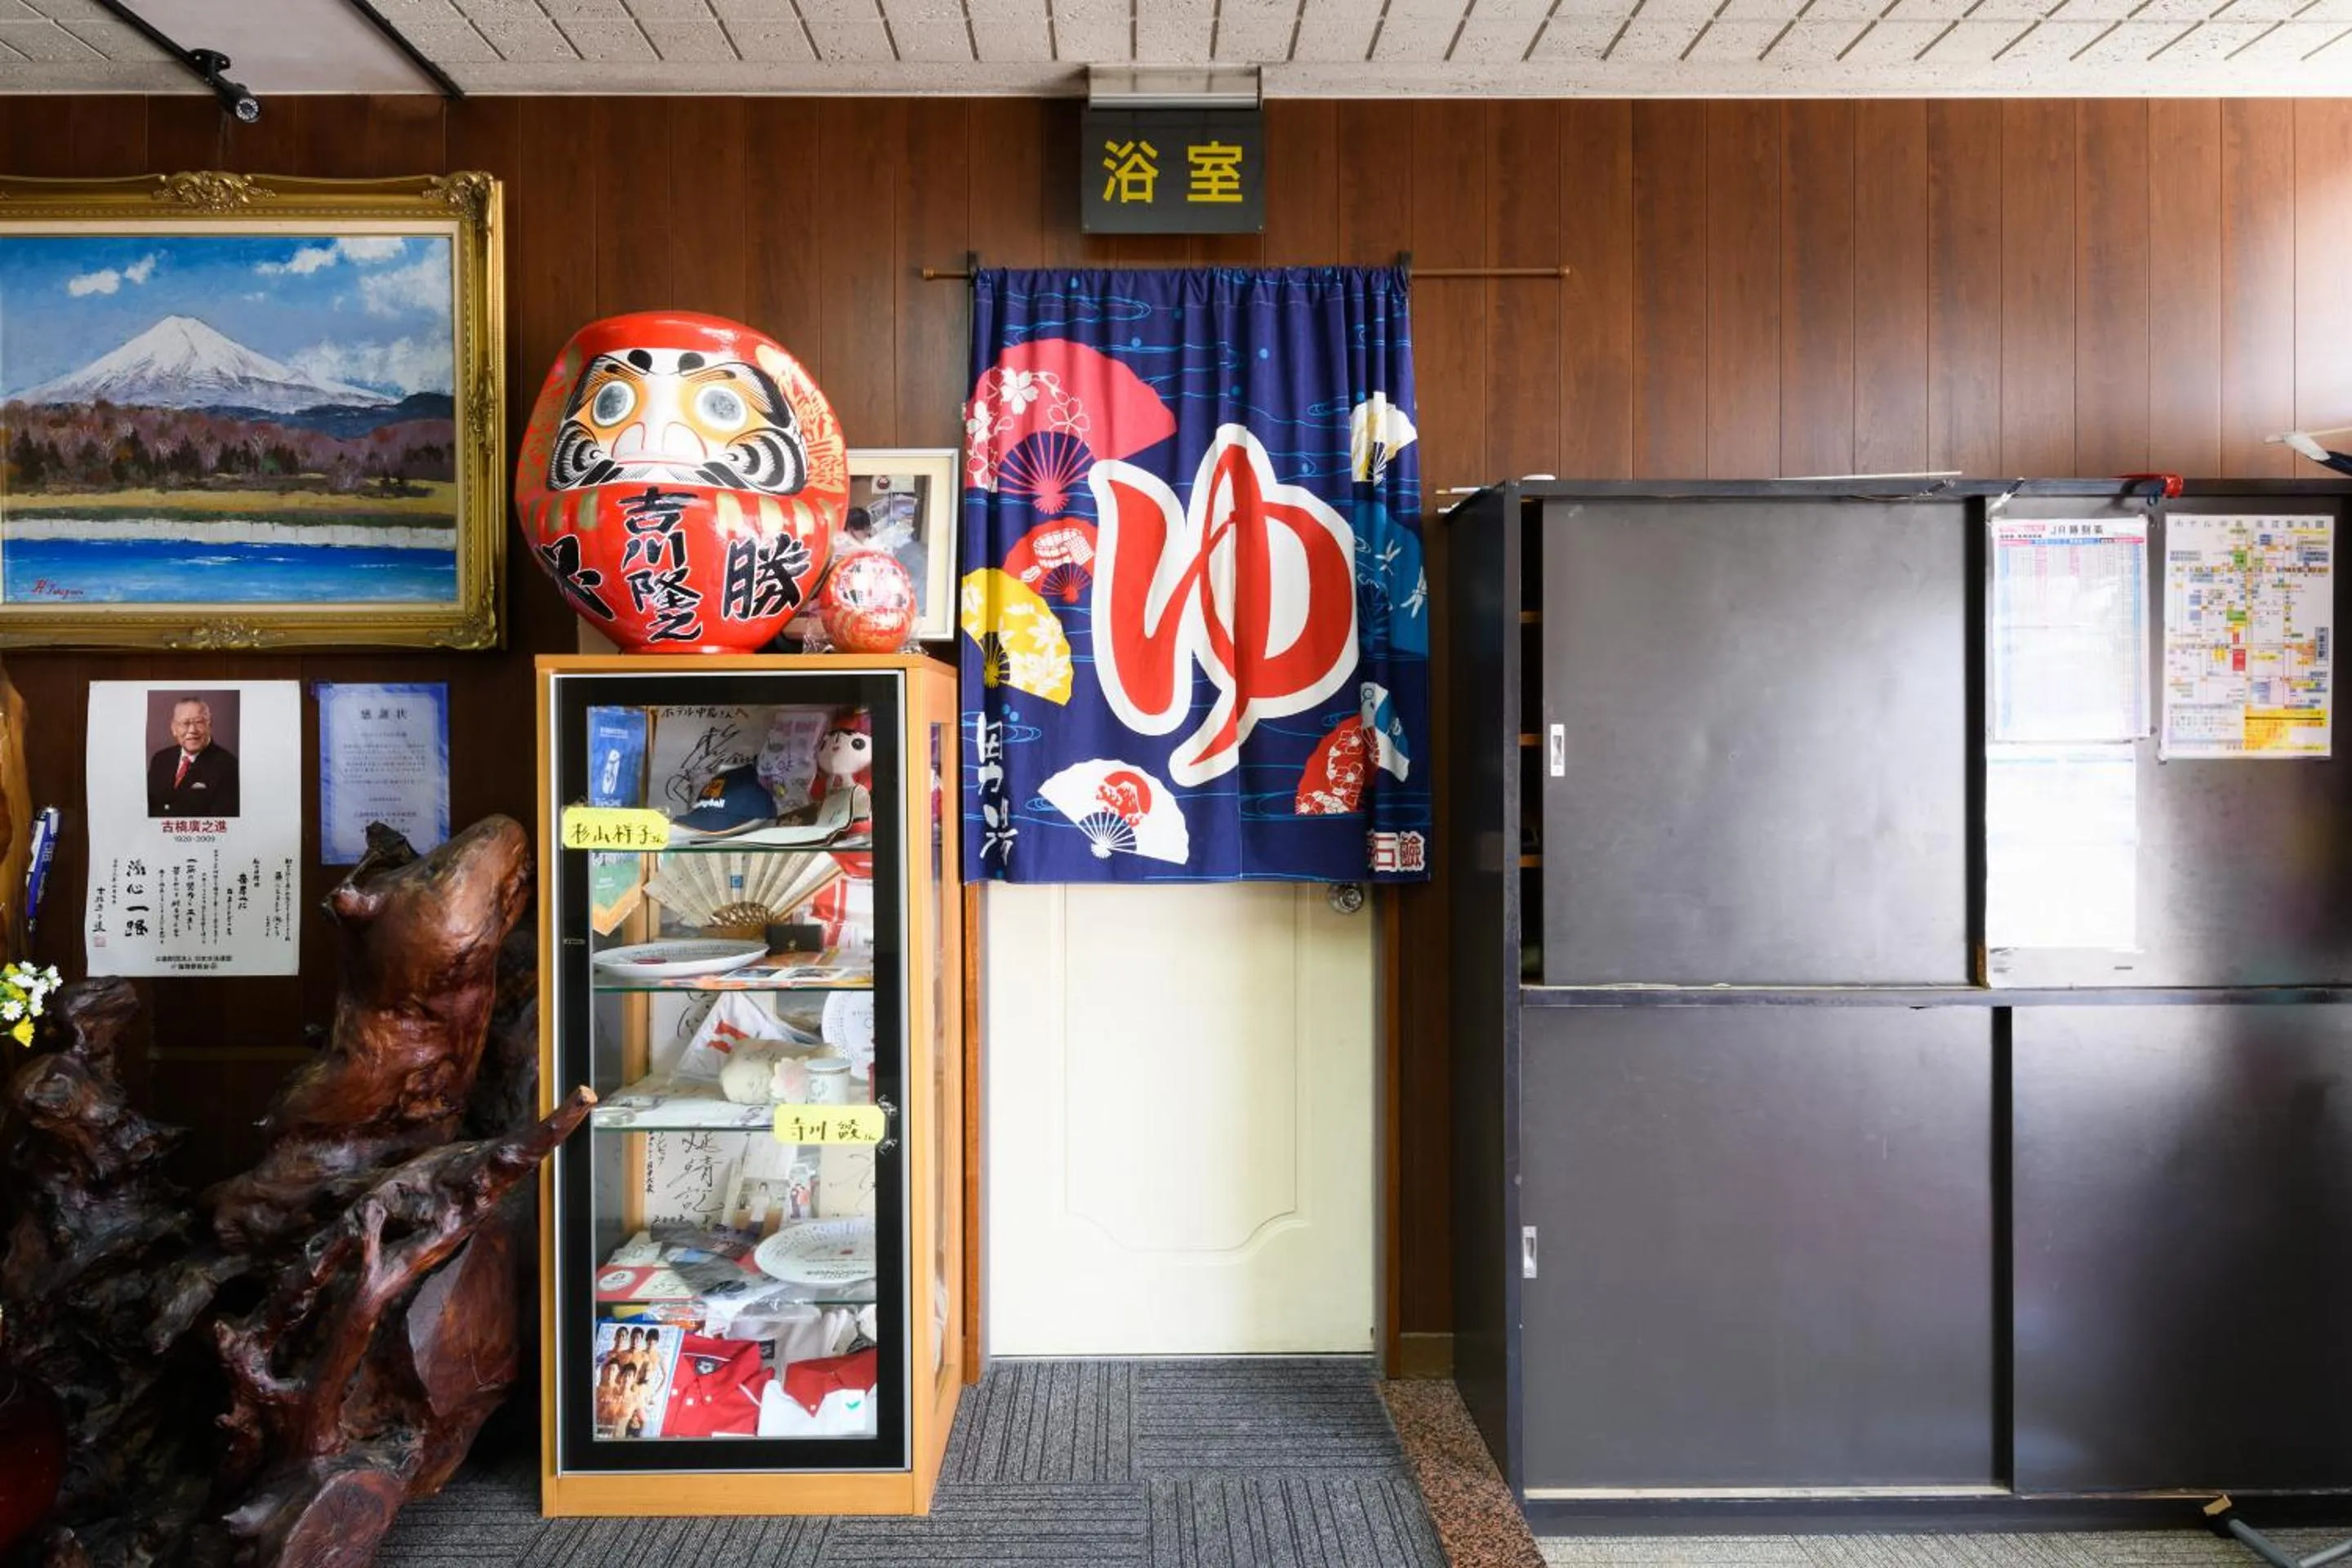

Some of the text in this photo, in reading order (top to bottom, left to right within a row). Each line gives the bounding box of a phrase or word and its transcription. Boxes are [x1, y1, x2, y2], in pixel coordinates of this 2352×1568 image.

[1102, 140, 1243, 203] 浴室
[722, 532, 813, 621] 勝
[1089, 424, 1359, 786] ゆ
